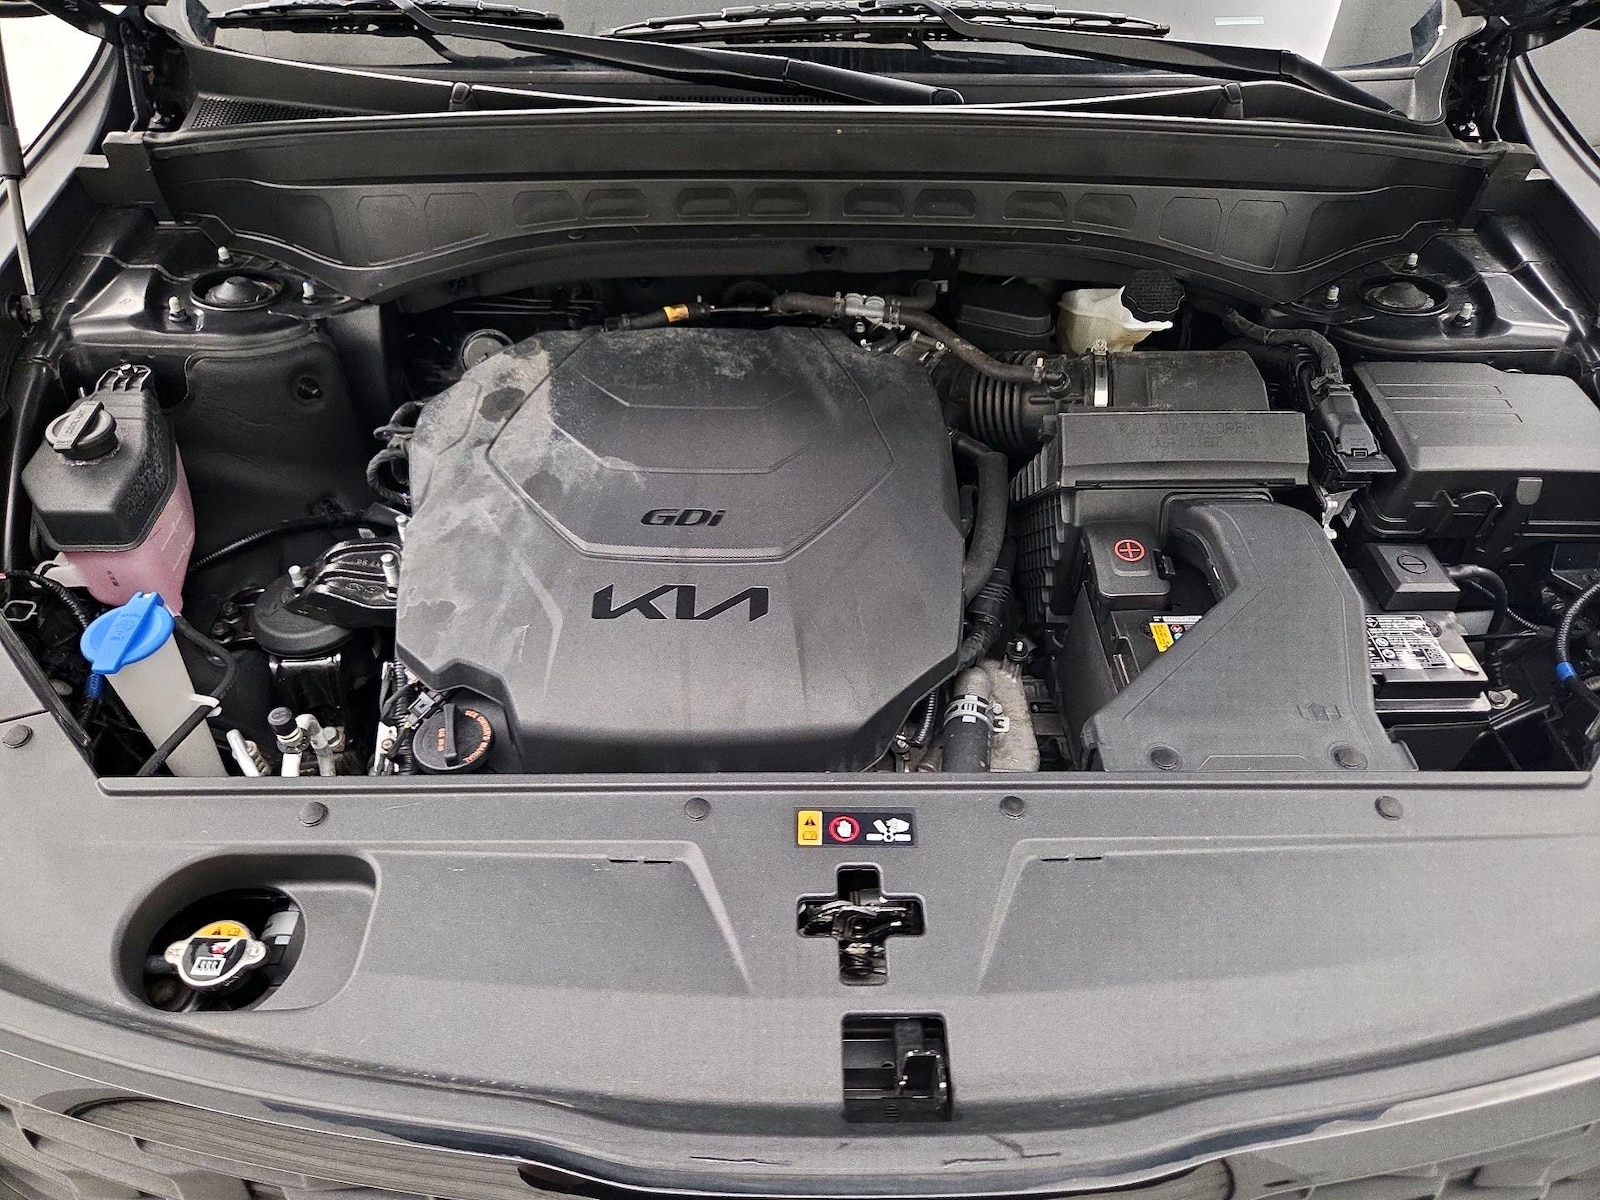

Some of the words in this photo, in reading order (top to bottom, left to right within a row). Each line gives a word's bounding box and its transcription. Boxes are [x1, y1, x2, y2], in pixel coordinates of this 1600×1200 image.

[1158, 422, 1188, 435] OUT
[1193, 422, 1211, 434] TO
[1215, 421, 1255, 435] OPEN
[641, 508, 725, 527] GDi
[591, 584, 769, 622] KIA
[465, 710, 479, 719] SEE
[477, 716, 491, 741] OWNER'S
[462, 742, 489, 763] MANUAL
